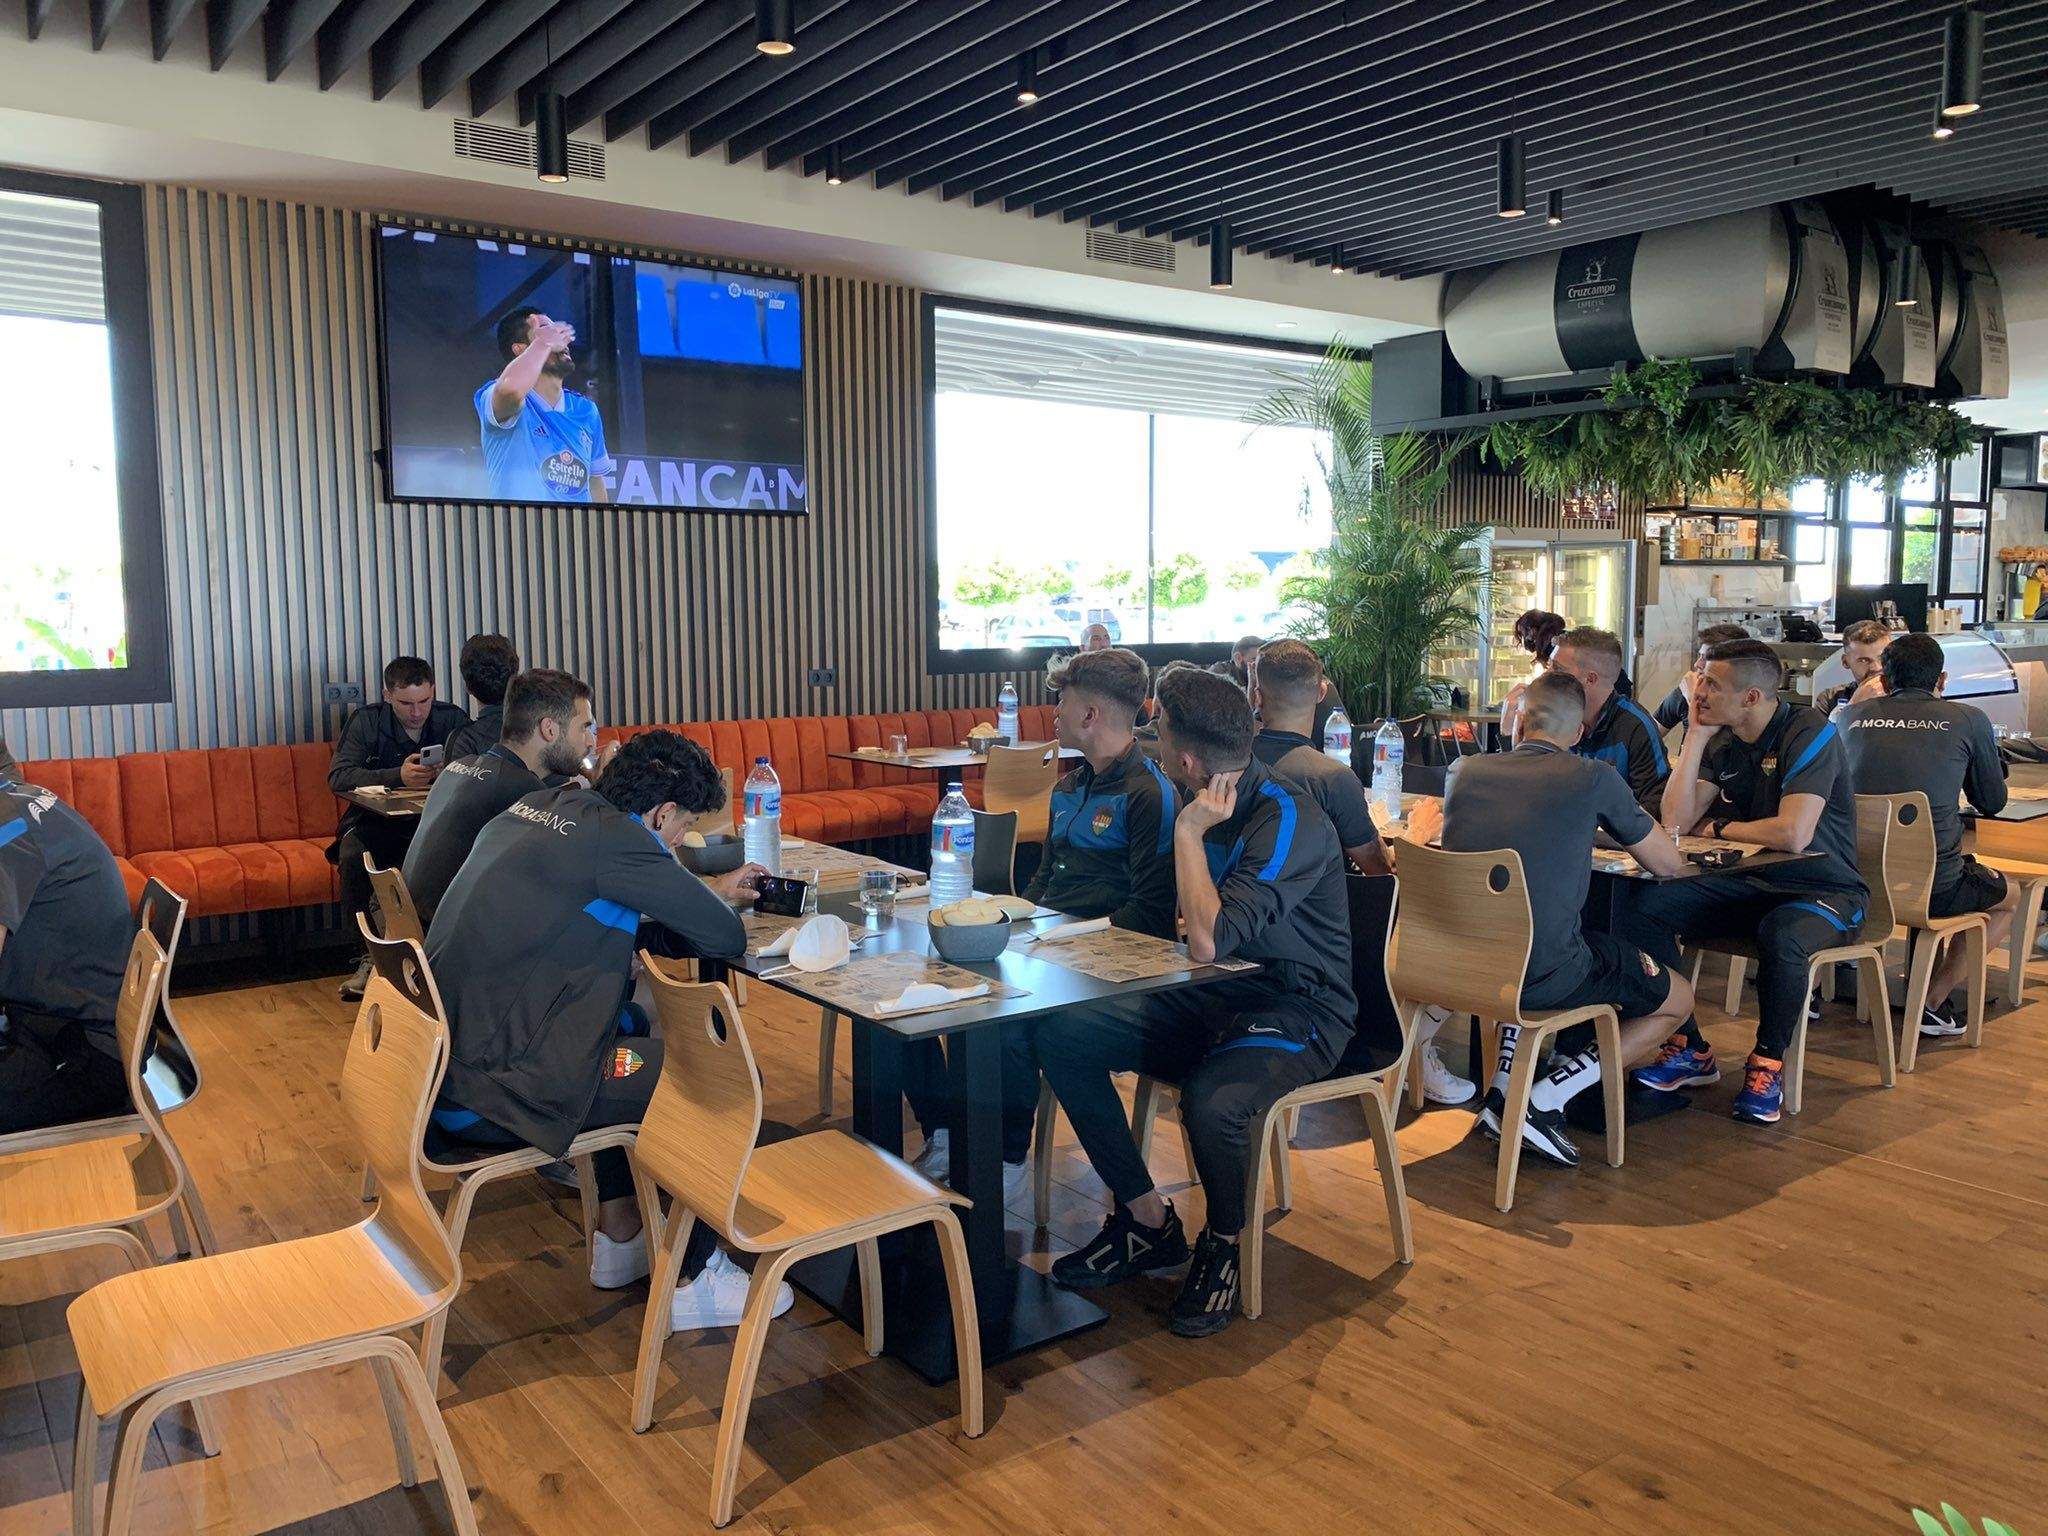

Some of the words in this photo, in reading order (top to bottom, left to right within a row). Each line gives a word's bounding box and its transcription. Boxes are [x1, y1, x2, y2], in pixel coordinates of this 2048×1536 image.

[1567, 284, 1616, 299] Cruzcampo
[549, 458, 585, 478] Estrella
[547, 470, 581, 489] Galicia
[1860, 718, 1951, 731] MORABANC
